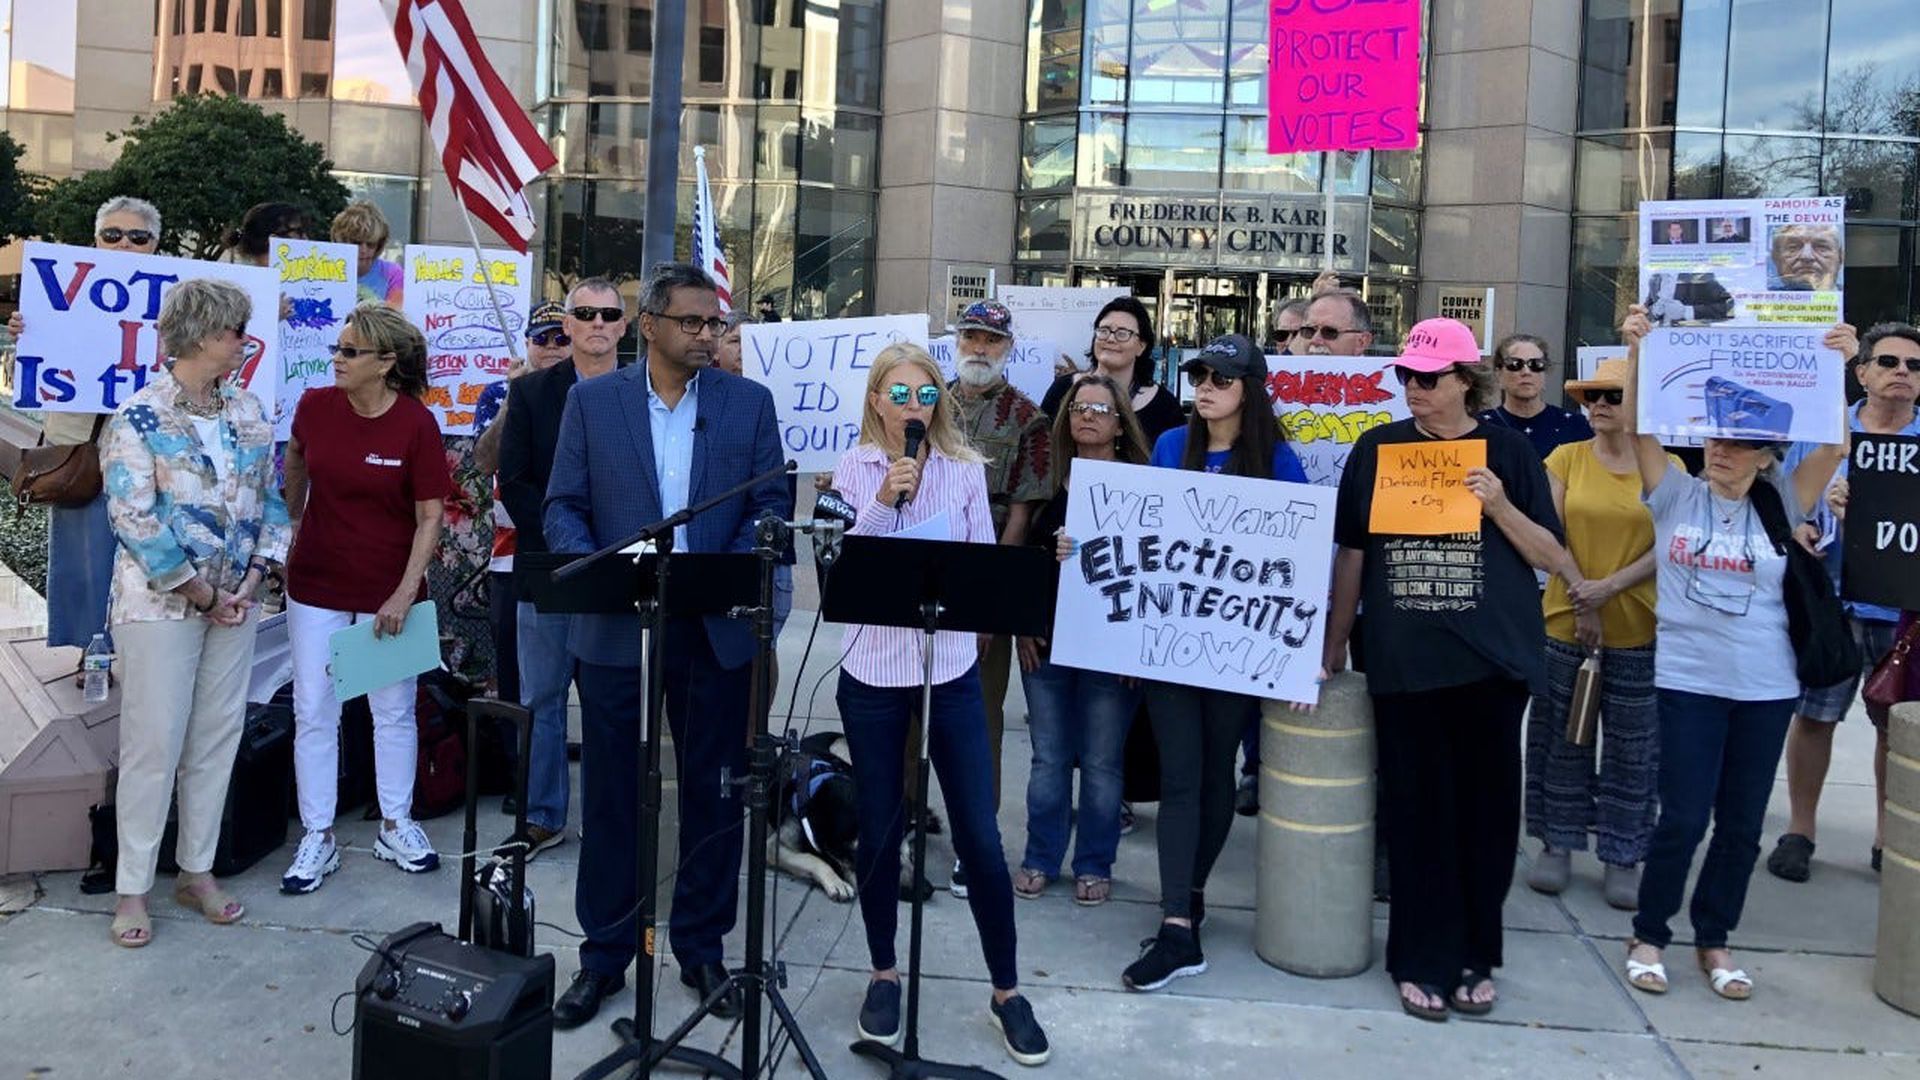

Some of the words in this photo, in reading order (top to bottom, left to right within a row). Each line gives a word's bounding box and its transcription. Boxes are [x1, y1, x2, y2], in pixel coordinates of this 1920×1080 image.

[1274, 26, 1408, 70] PROTECT
[1298, 74, 1367, 103] OUR
[1280, 107, 1405, 146] VOTES
[1108, 203, 1237, 222] FREDERICK
[1247, 206, 1264, 223] B.
[1765, 199, 1819, 208] FAMOUS
[1824, 199, 1841, 208] AS
[1764, 213, 1790, 223] THE
[1794, 213, 1839, 223] DEVIL!
[1094, 225, 1218, 250] COUNTY
[1226, 229, 1348, 256] CENTER
[951, 275, 986, 287] COUNTY
[951, 287, 985, 299] CENTER
[1442, 296, 1483, 307] COUNTY
[426, 313, 457, 332] NOT
[1441, 308, 1480, 319] CENTER
[1669, 332, 1724, 346] DON'T
[1729, 333, 1816, 350] SACRIFICE
[15, 356, 76, 408] Is
[792, 381, 839, 412] ID
[1089, 483, 1164, 531] WE
[1408, 582, 1433, 596] COME
[1435, 583, 1446, 596] TO
[1448, 583, 1474, 597] LIGHT
